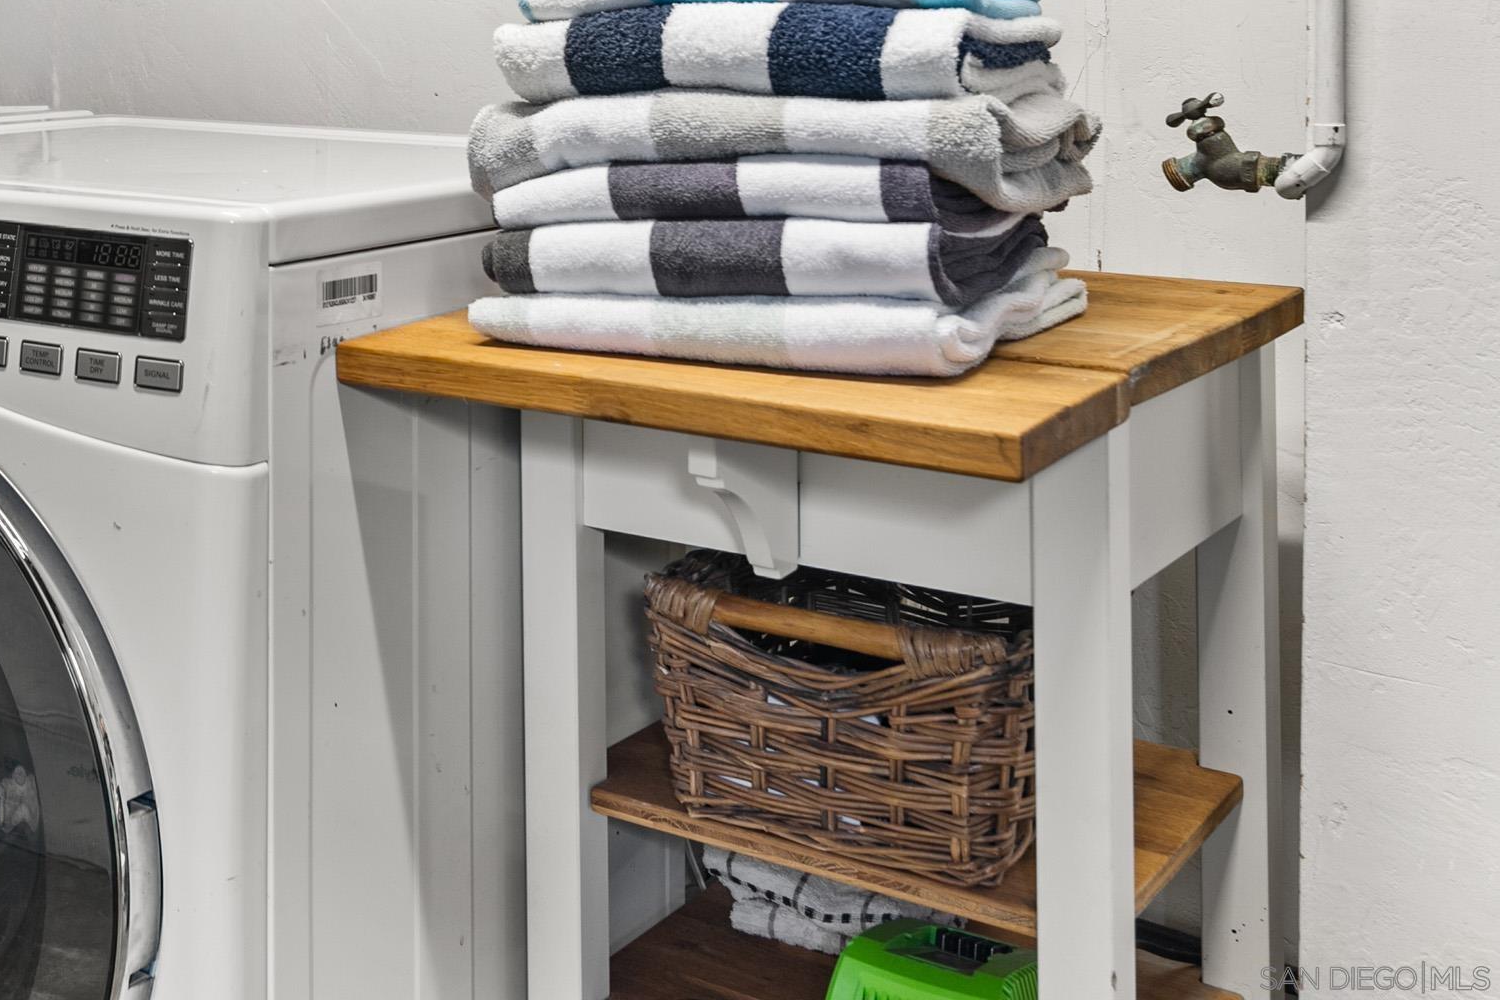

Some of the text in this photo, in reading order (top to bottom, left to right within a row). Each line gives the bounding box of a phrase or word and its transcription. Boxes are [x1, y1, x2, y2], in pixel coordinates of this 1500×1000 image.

[156, 250, 185, 259] MORE TIME
[154, 274, 167, 282] LESS
[25, 358, 55, 368] CONTROL
[89, 357, 105, 366] TIME
[90, 366, 103, 374] DRY
[144, 369, 170, 380] SIGNAL
